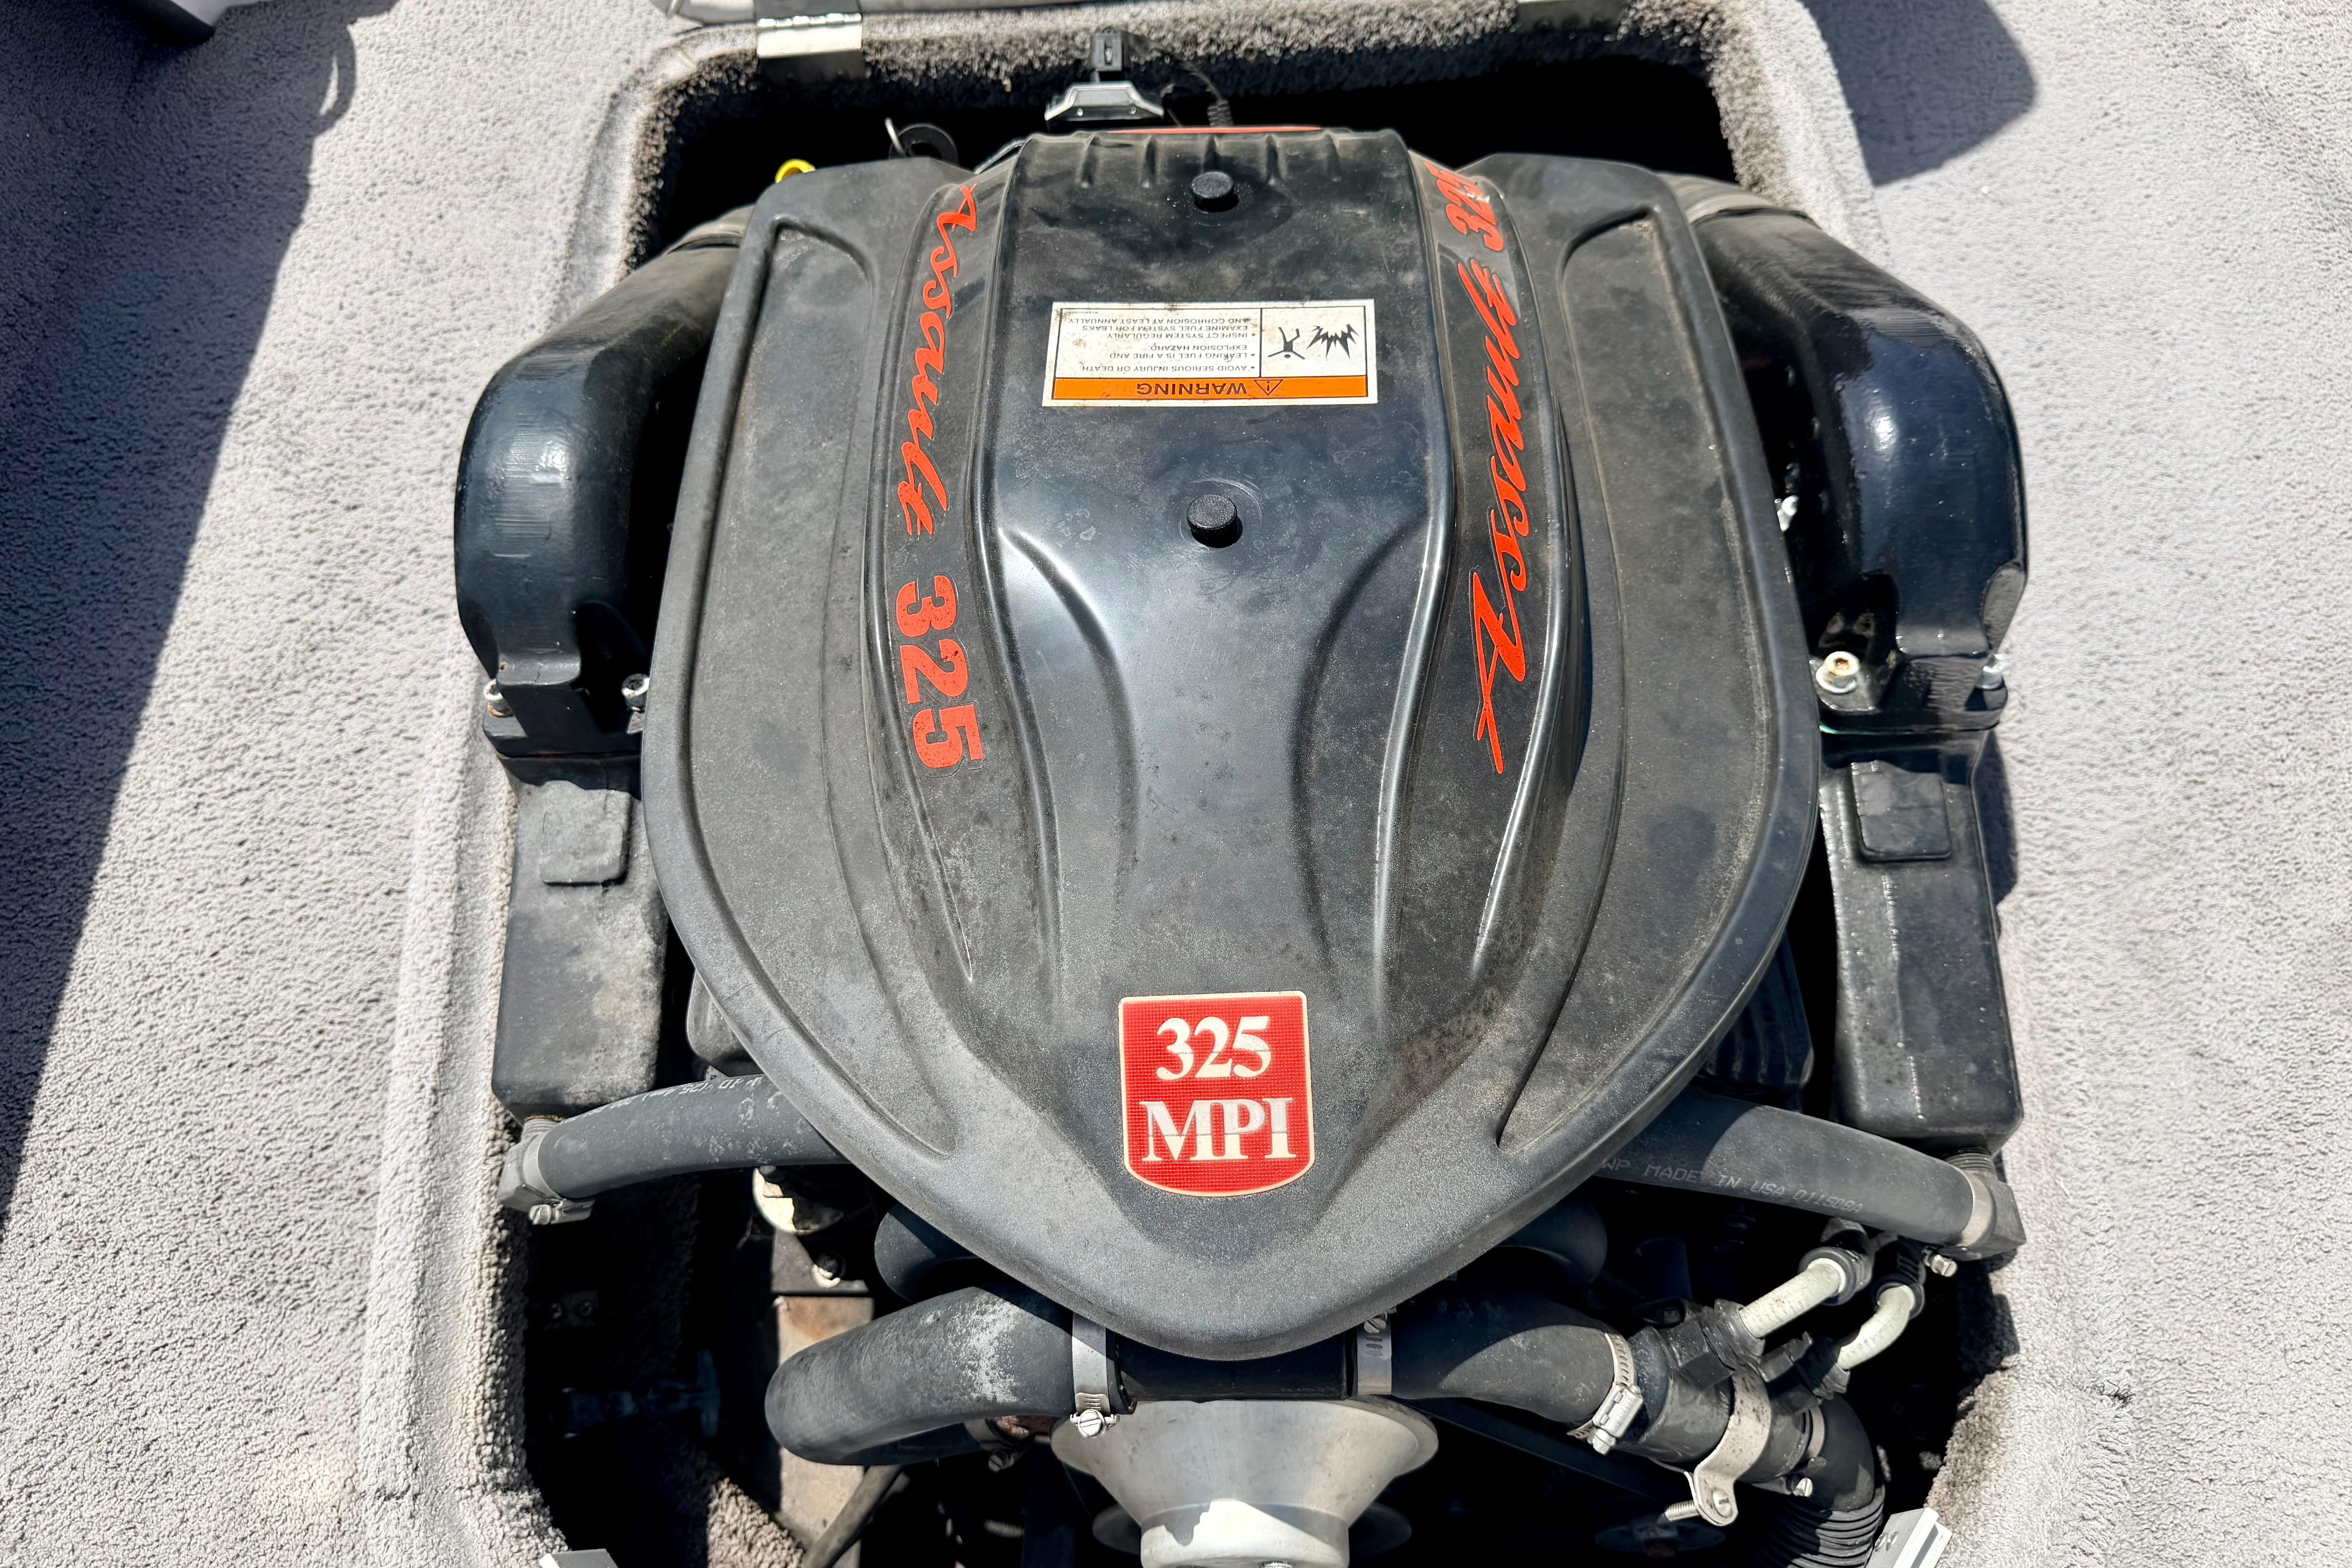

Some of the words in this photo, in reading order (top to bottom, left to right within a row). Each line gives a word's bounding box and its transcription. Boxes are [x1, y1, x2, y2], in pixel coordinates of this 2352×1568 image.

[1423, 161, 1504, 252] 325
[898, 187, 977, 536] Assault
[1136, 383, 1247, 395] WARNING
[1457, 259, 1530, 775] Assault
[897, 576, 982, 768] 325
[1156, 1015, 1272, 1080] 325
[1139, 1097, 1297, 1161] MPI
[1642, 1164, 1702, 1183] MADE
[1715, 1174, 1742, 1189] IN
[1750, 1179, 1785, 1196] USA
